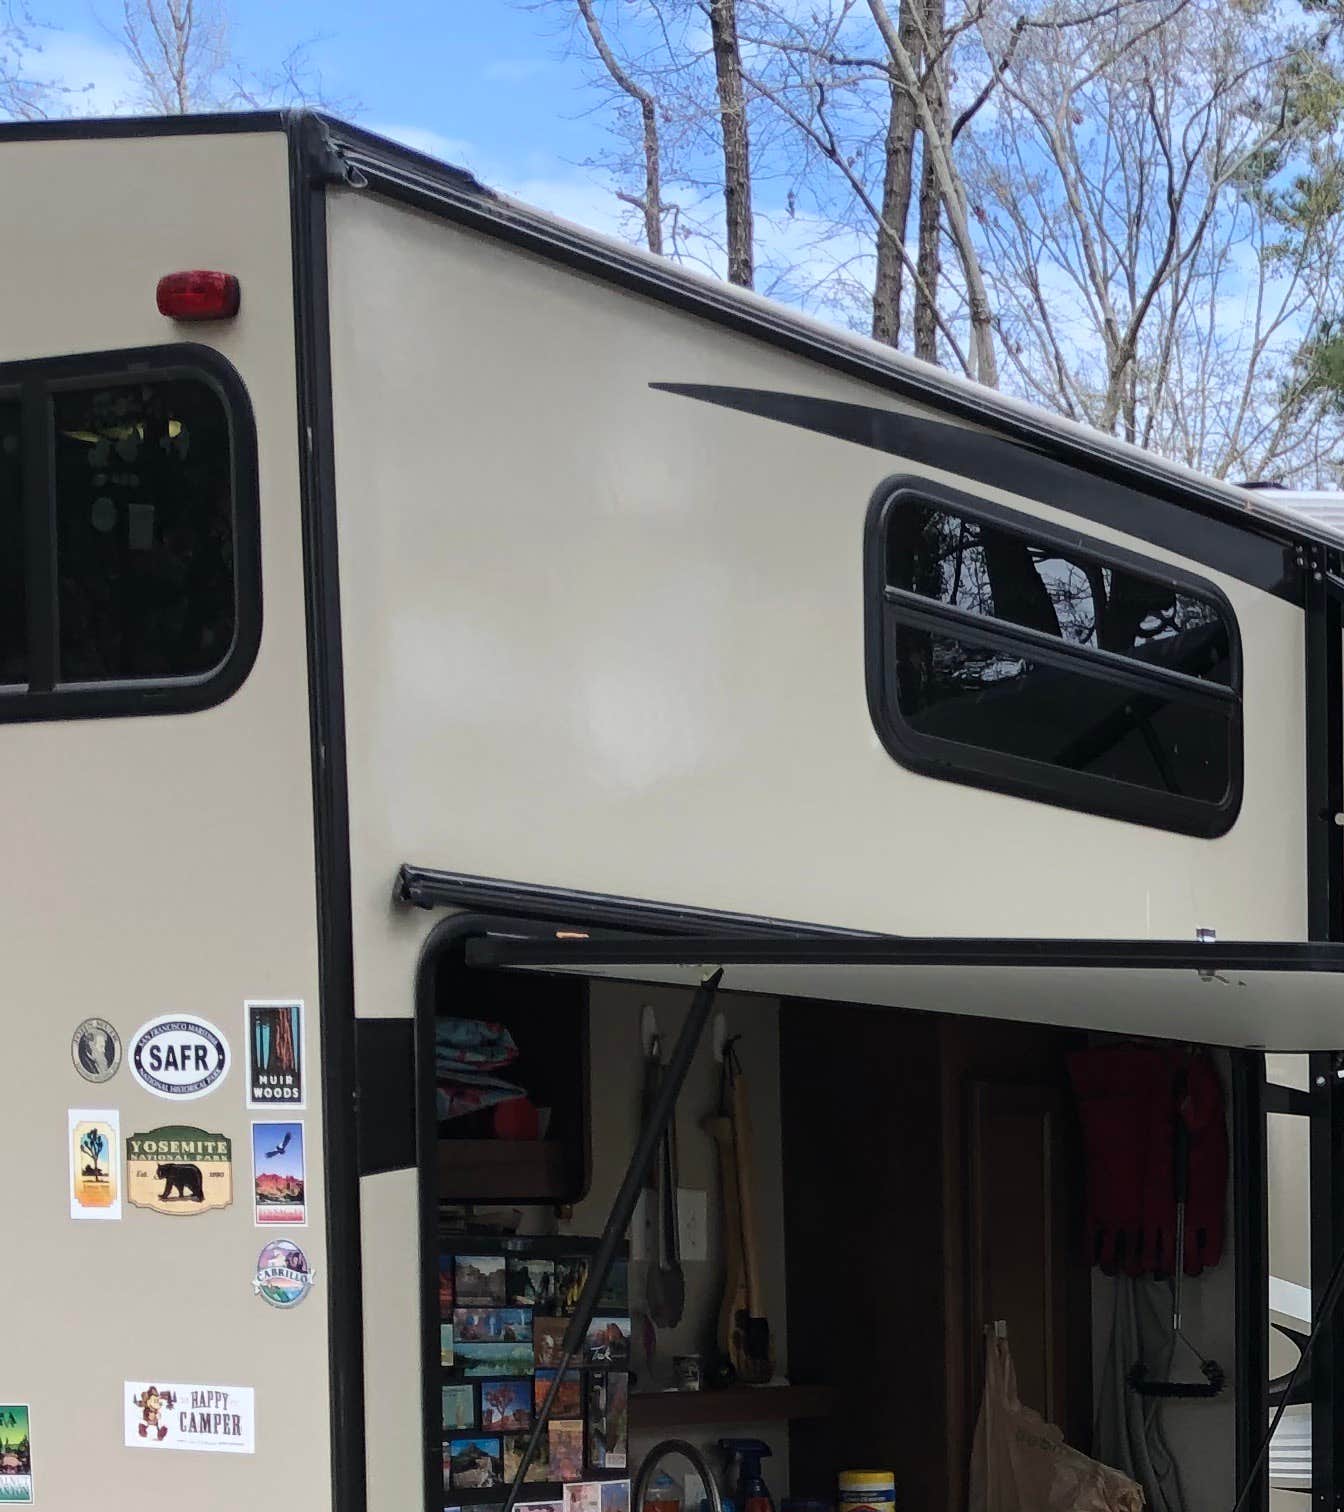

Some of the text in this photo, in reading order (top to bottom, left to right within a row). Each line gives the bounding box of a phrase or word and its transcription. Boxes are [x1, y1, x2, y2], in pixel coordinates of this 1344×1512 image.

[149, 1045, 209, 1071] SAFR
[259, 1075, 293, 1085] MUIR
[253, 1087, 299, 1098] WOODS
[131, 1140, 228, 1154] YOSEMITE
[257, 1268, 308, 1283] CABRILLO
[191, 1390, 229, 1410] HAPPY
[179, 1411, 242, 1436] CAMPER
